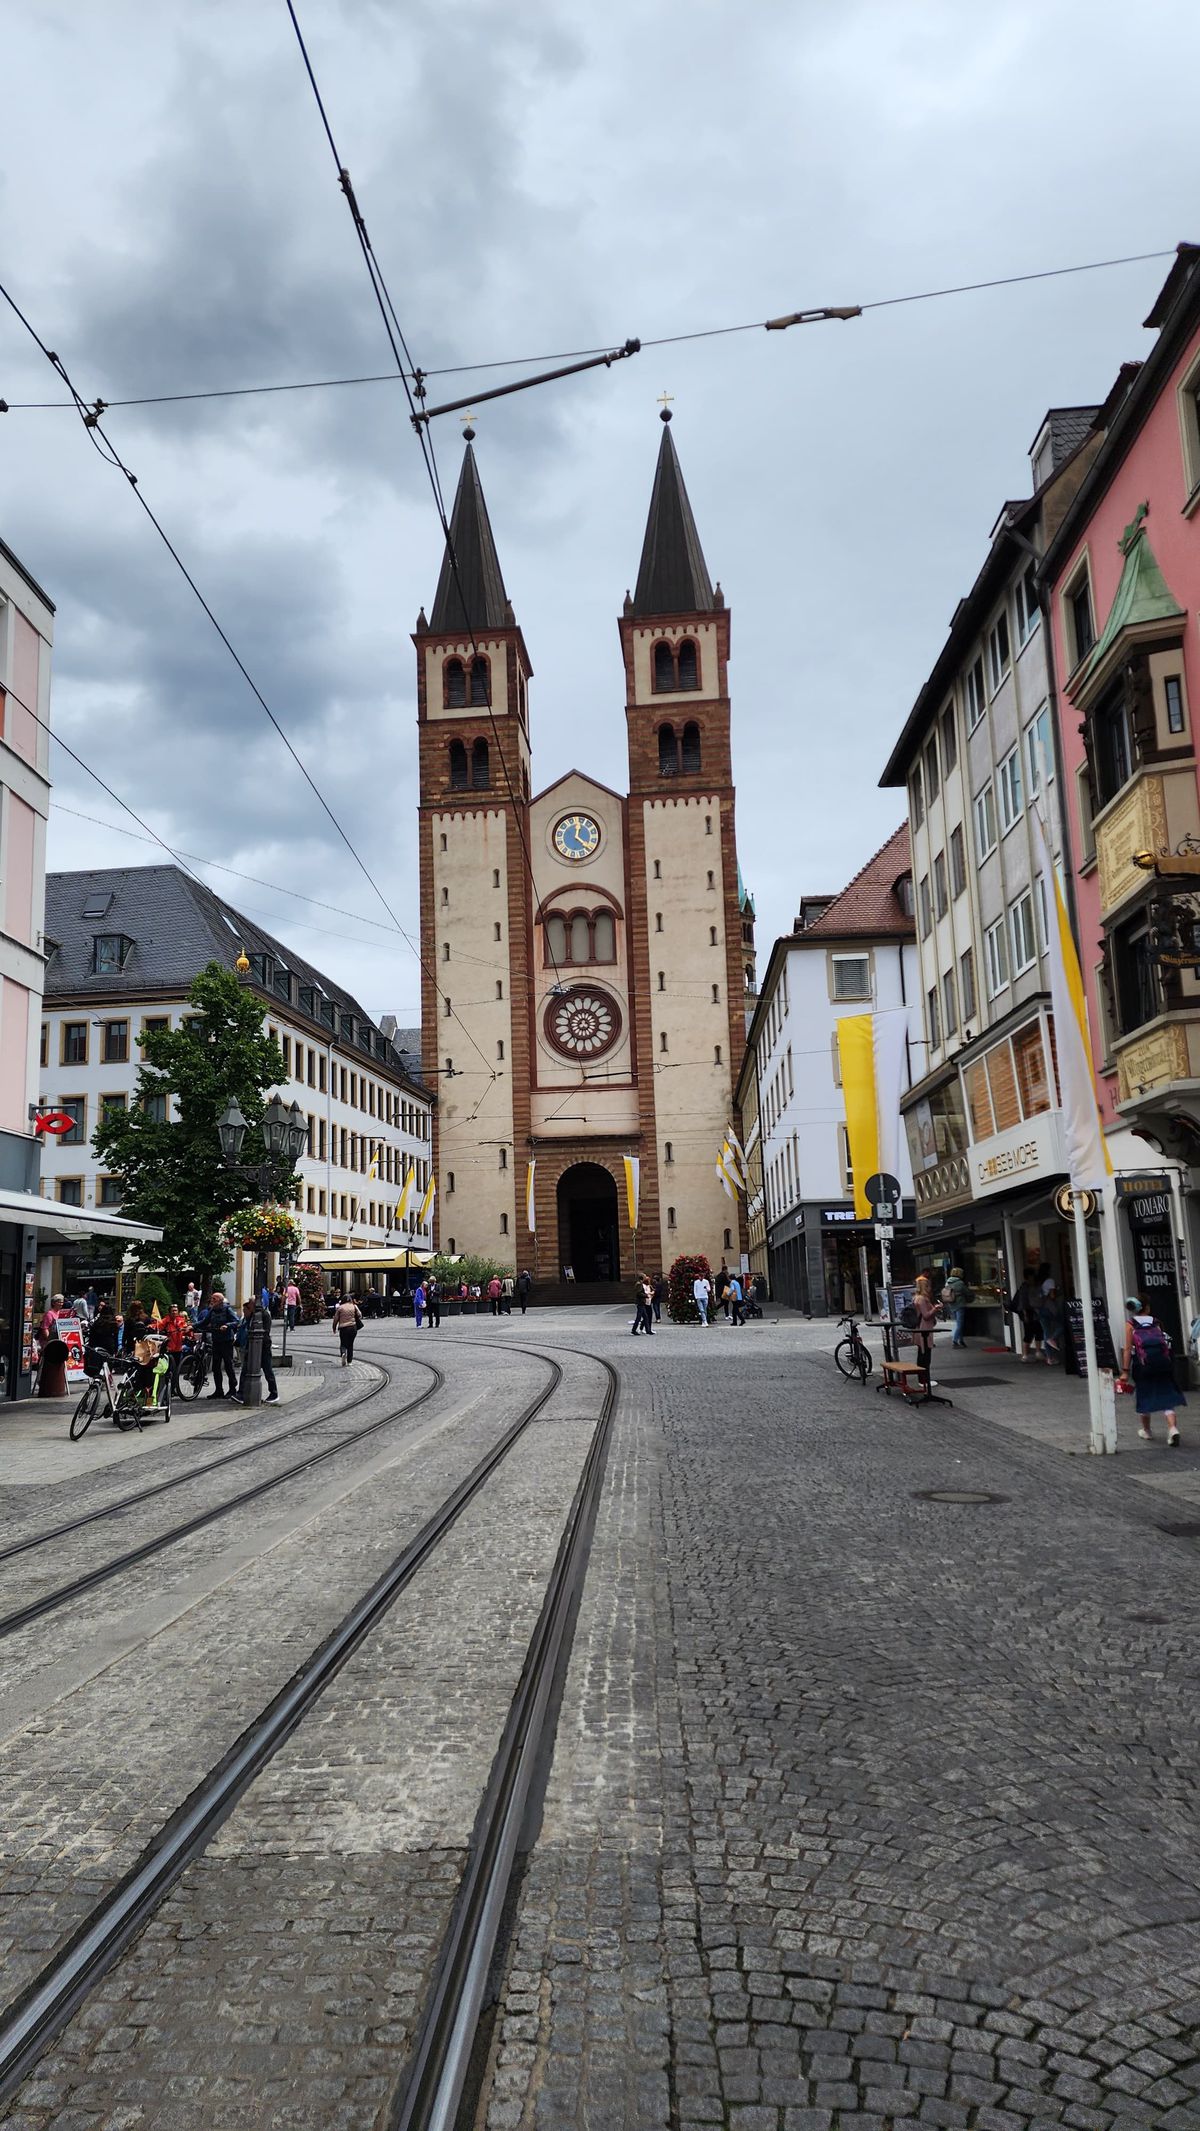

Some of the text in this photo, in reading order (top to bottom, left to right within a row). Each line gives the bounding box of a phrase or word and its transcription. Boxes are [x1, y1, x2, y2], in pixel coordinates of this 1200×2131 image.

[1123, 1180, 1164, 1192] HOTEL
[1133, 1193, 1170, 1218] YOMARO
[824, 1210, 871, 1221] TRE
[1141, 1234, 1173, 1247] WELC
[1142, 1248, 1155, 1260] TO
[1144, 1260, 1176, 1274] PLEAS
[1146, 1274, 1172, 1287] DOM.
[1067, 1299, 1102, 1309] YOMRO
